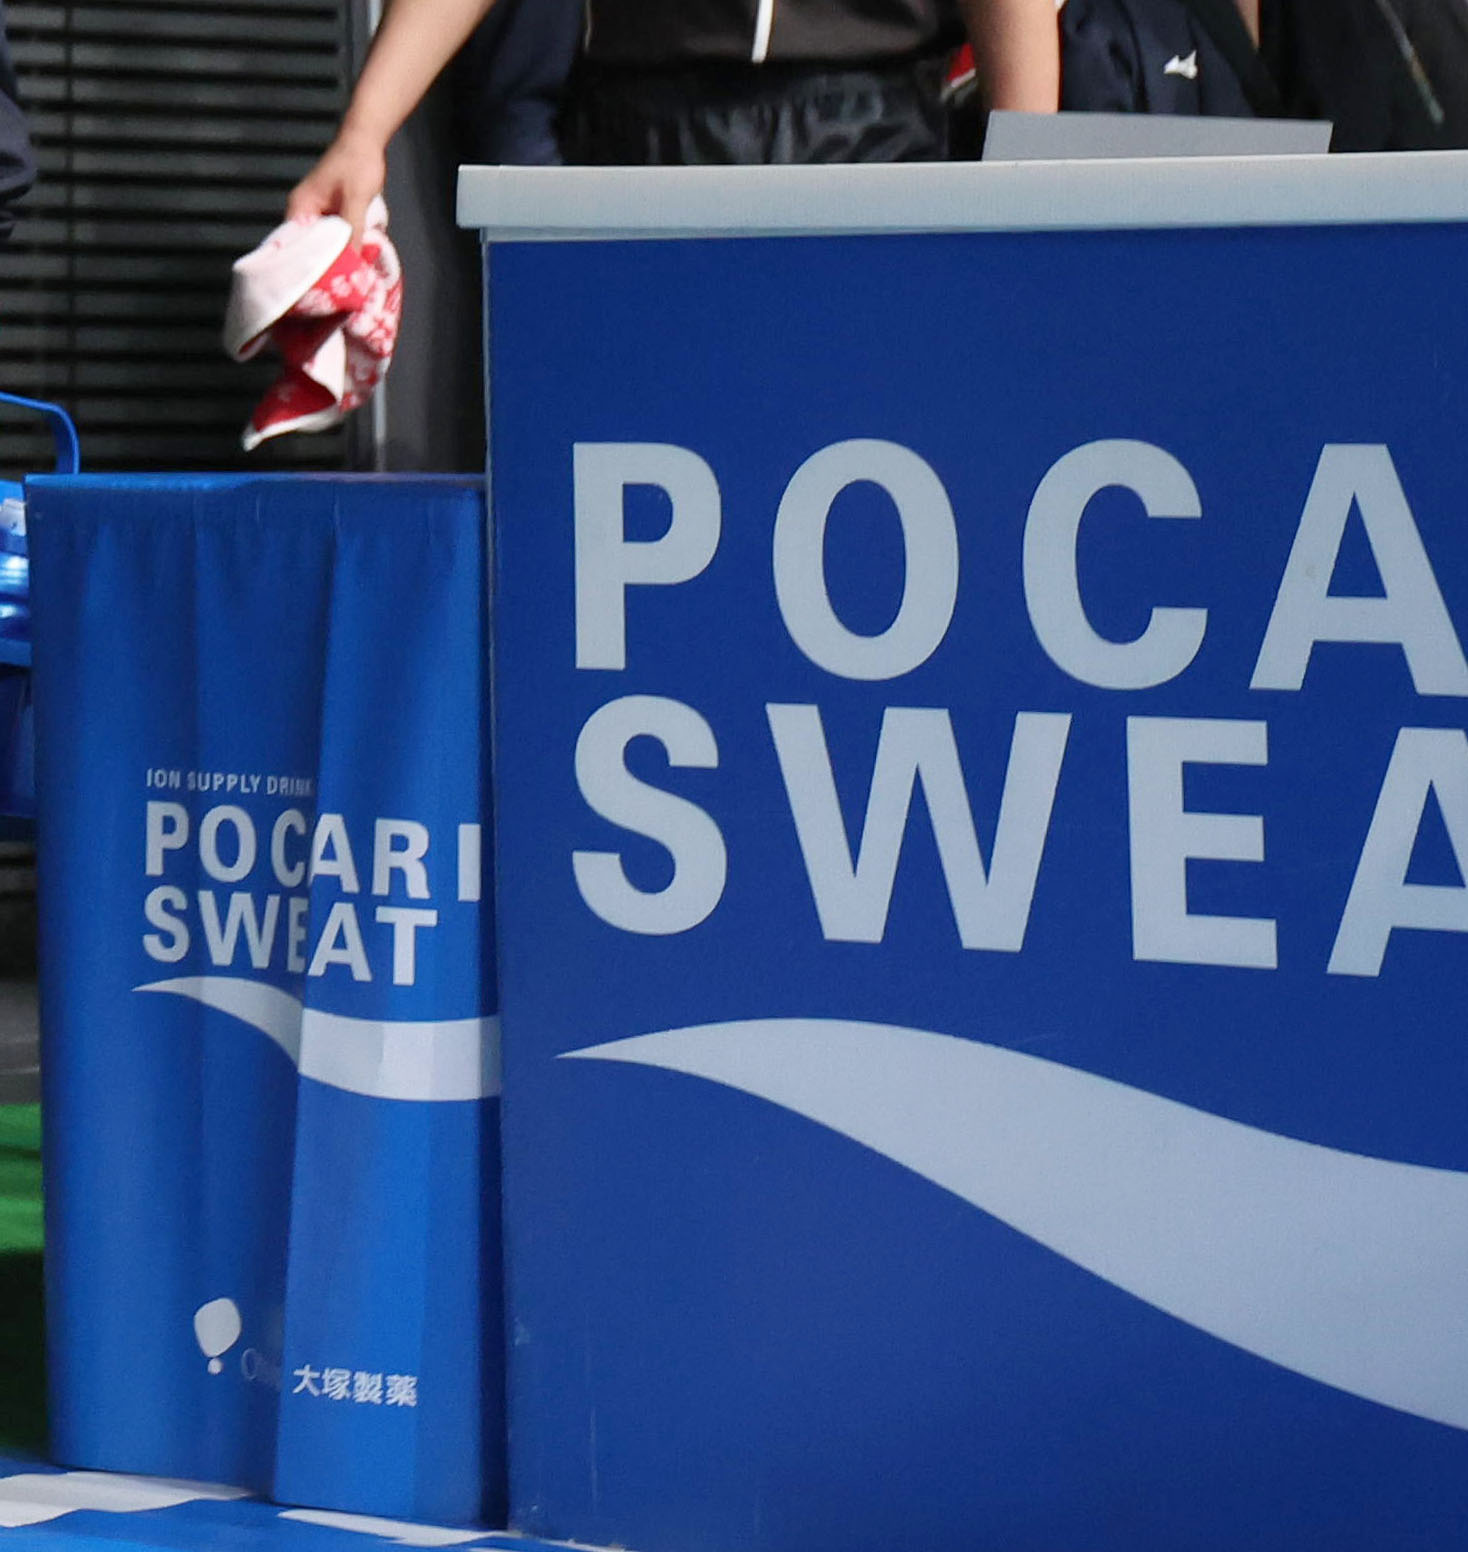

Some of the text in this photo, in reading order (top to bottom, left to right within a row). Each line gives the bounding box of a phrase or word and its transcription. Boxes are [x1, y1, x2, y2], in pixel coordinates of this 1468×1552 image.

[572, 438, 1468, 697] POCA
[145, 767, 181, 790] ION
[187, 770, 262, 795] SUPPLY
[144, 800, 482, 903] POCARI
[142, 886, 438, 986] SWEAT
[292, 1363, 419, 1408] 大塚製薬
